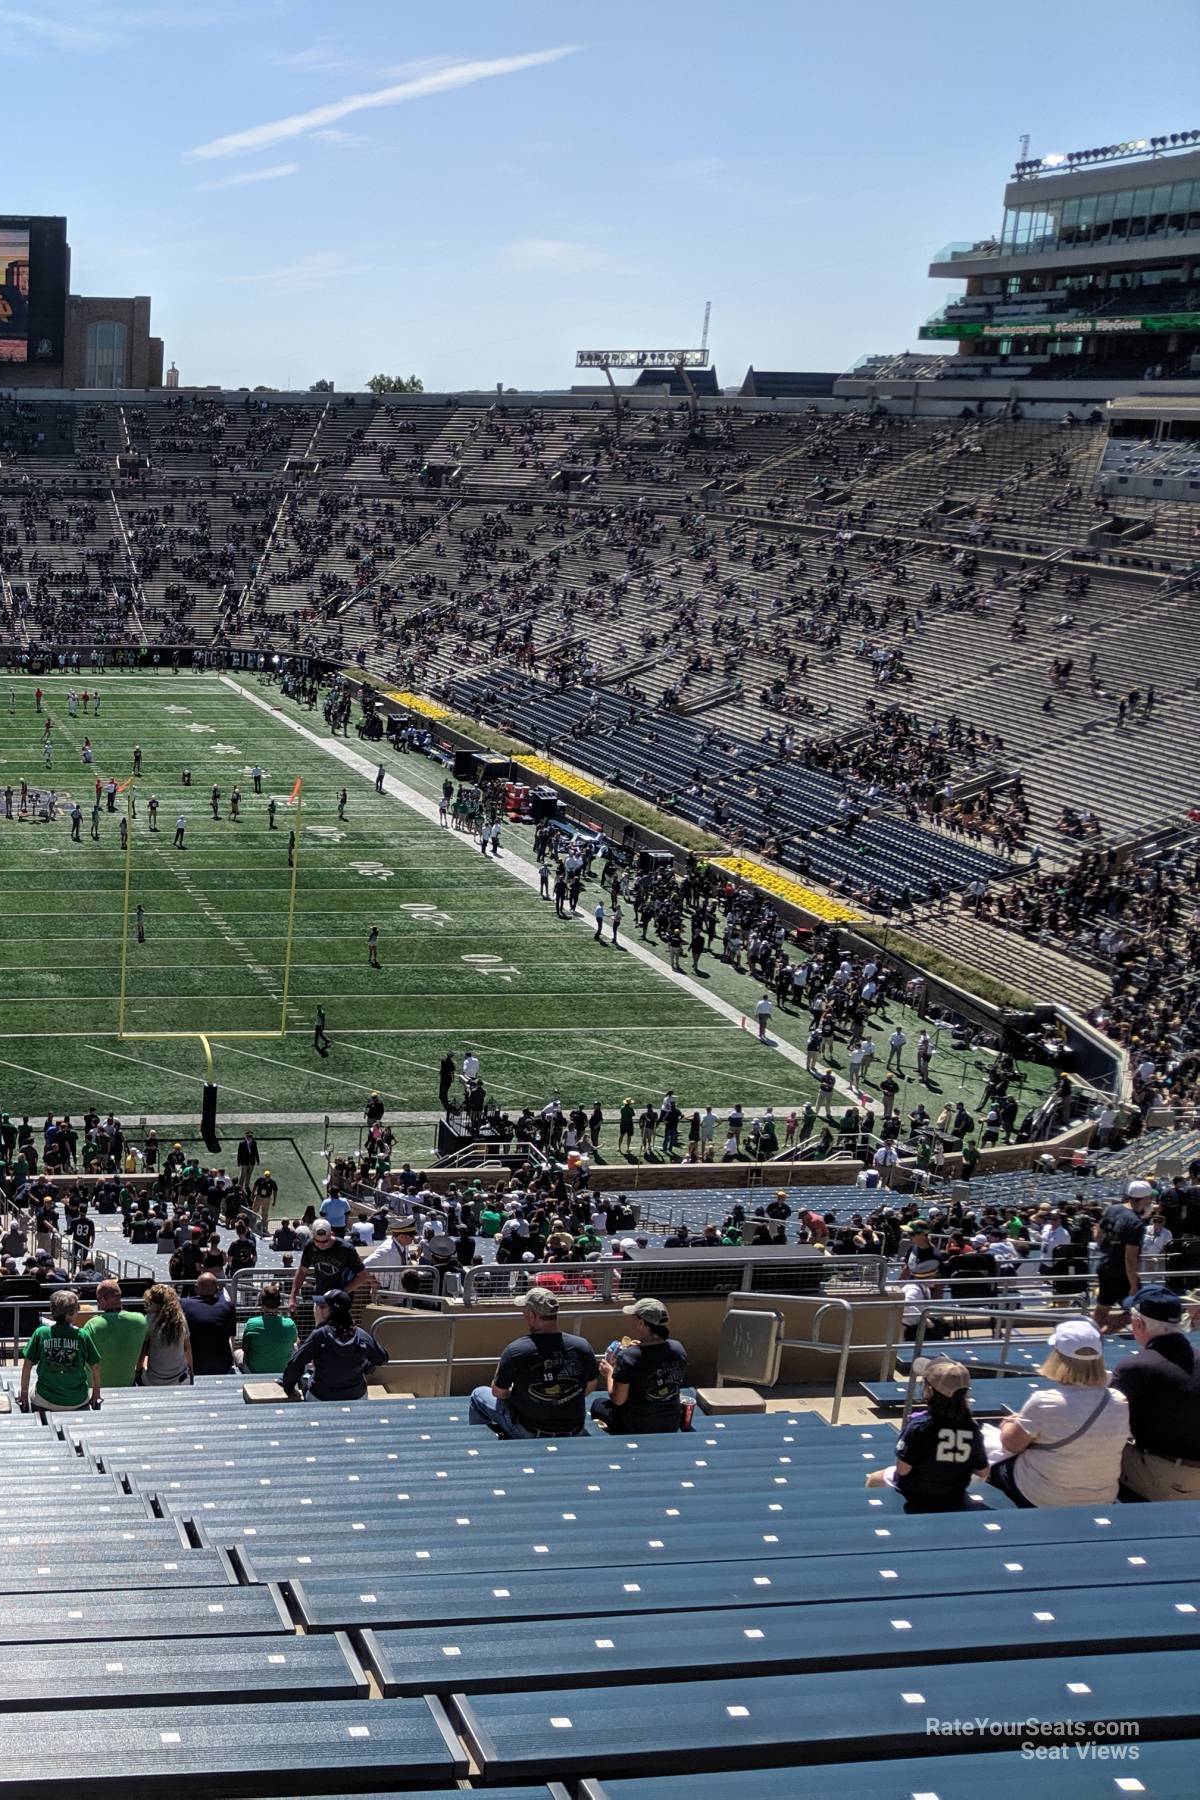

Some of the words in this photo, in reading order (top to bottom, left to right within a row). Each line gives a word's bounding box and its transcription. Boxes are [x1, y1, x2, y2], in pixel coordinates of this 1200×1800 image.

[460, 953, 522, 975] 10
[76, 1224, 90, 1237] 83
[63, 1337, 80, 1351] DAME
[936, 1428, 974, 1463] 25
